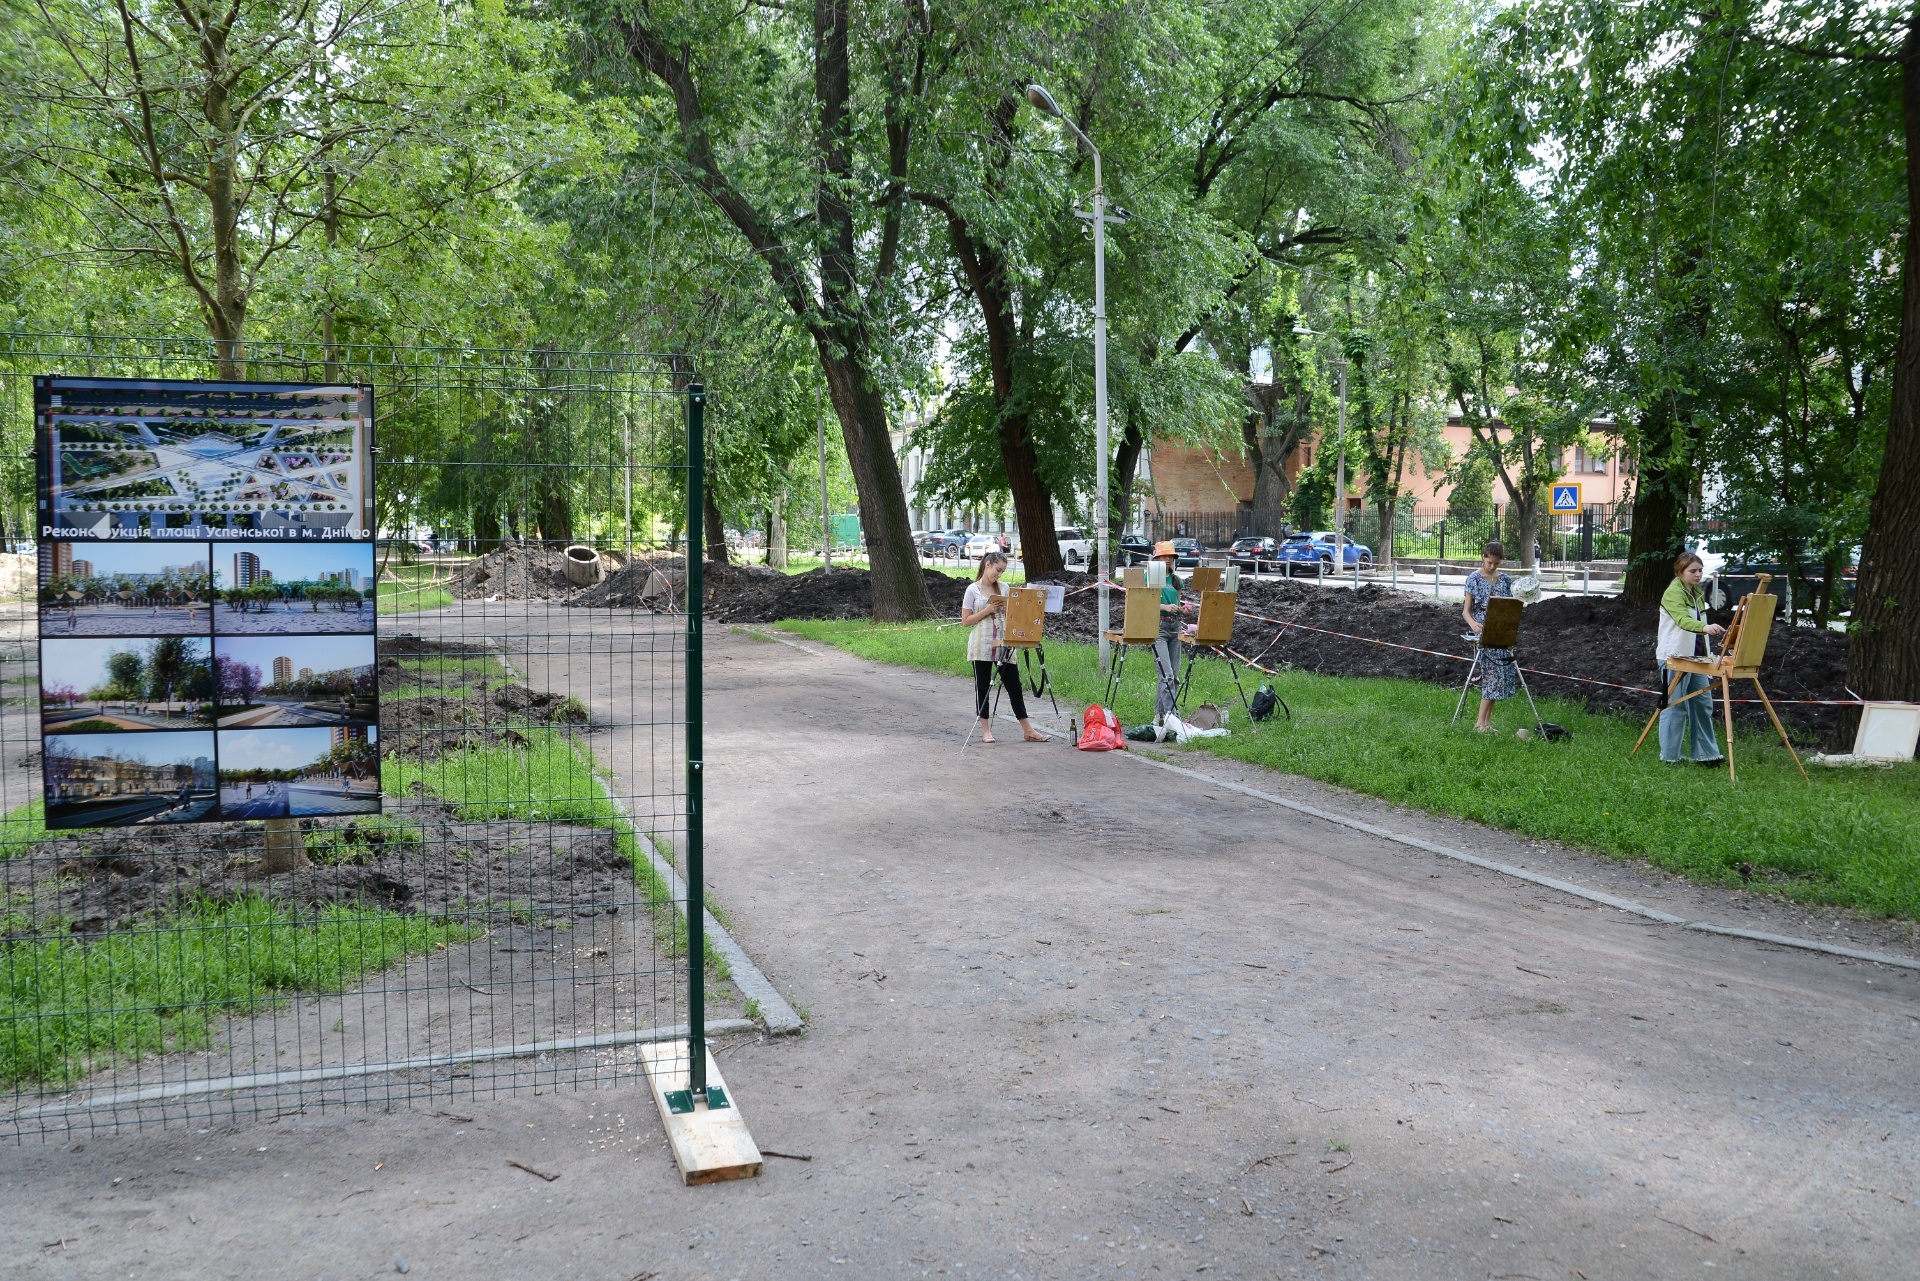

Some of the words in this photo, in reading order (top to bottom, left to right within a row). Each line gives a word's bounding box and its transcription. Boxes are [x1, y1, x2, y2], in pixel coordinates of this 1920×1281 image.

[157, 525, 201, 539] площі
[205, 525, 285, 538] Успенської
[289, 528, 297, 538] в
[302, 528, 316, 538] м.
[321, 526, 371, 540] Дніпро
